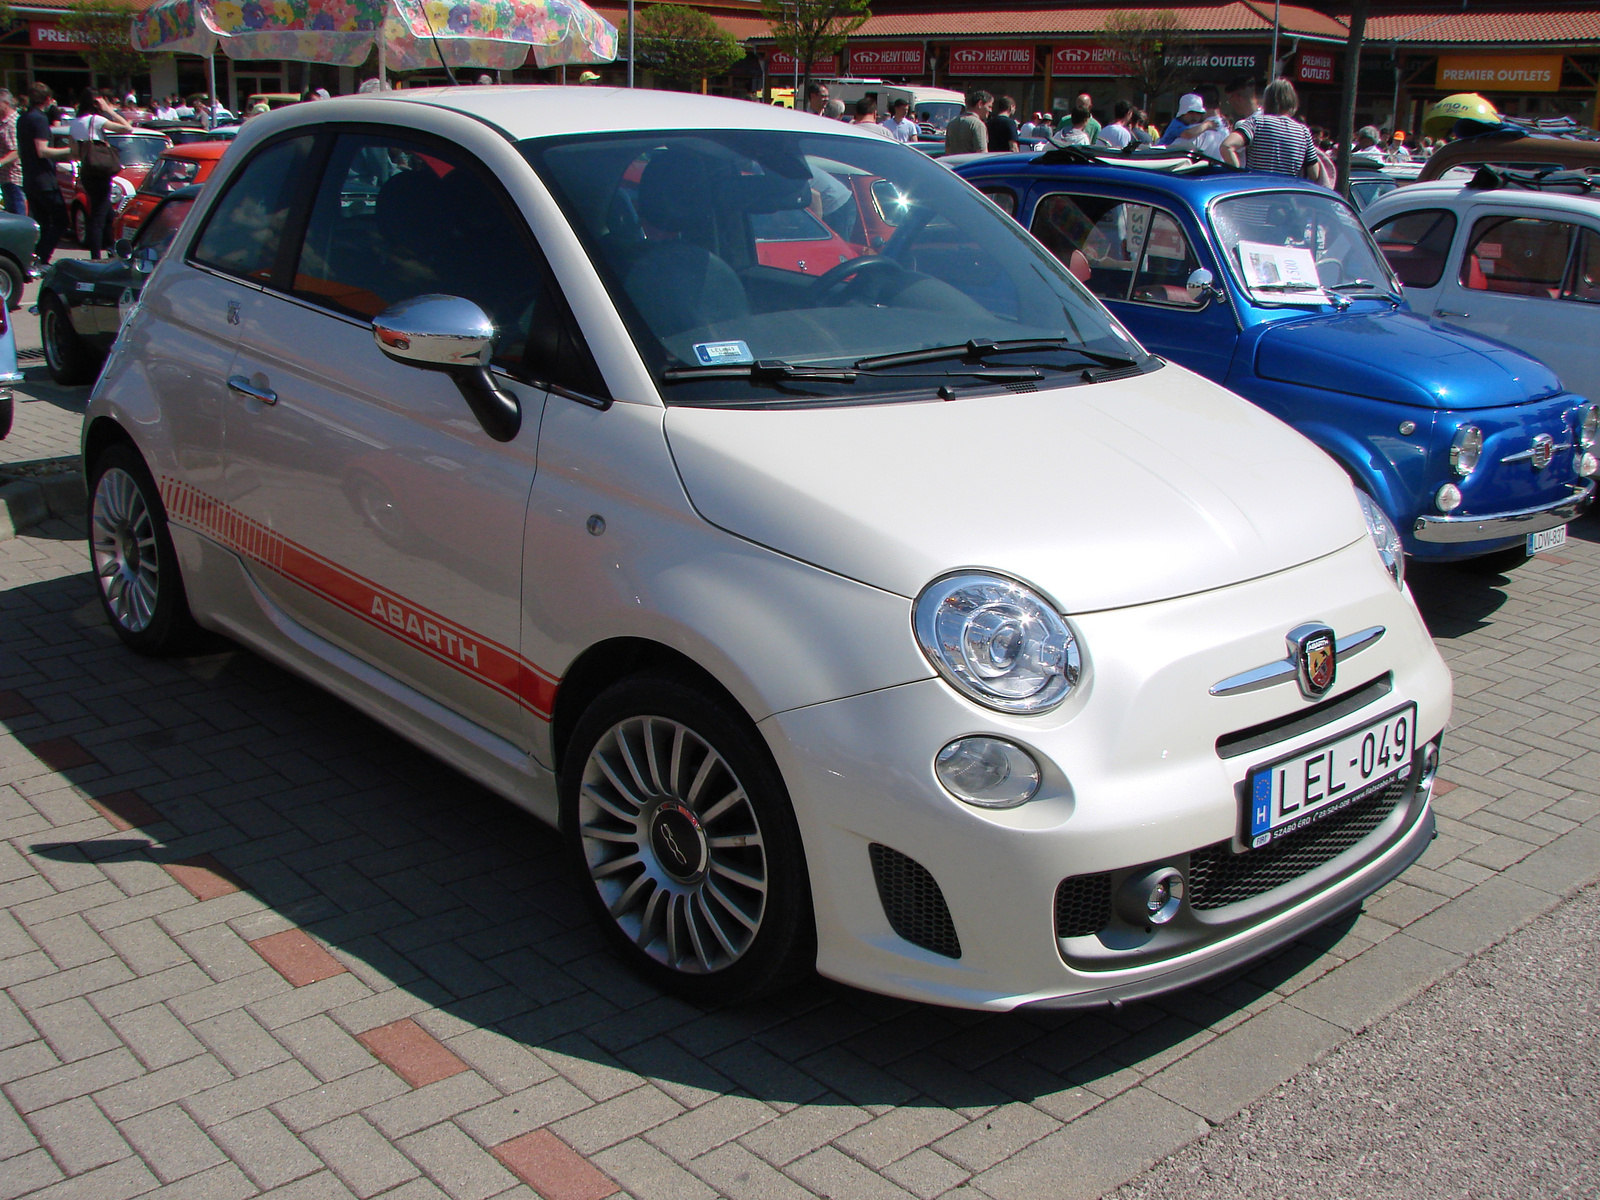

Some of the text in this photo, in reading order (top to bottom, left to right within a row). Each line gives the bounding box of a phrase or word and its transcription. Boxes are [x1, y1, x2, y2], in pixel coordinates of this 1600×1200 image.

[880, 50, 902, 63] HEAVY
[901, 50, 921, 63] TOOLS
[985, 49, 1008, 62] HEAVY
[1008, 49, 1030, 62] TOOLS
[1091, 48, 1117, 62] HEAVY
[1210, 55, 1256, 68] OUTLETS
[1301, 55, 1332, 68] PREMIER
[1301, 68, 1331, 81] OUTLETS
[1442, 69, 1552, 82] PREMIER OUTLETS
[1534, 527, 1565, 550] LDW-837
[371, 595, 481, 670] ABARTH
[1278, 716, 1408, 818] LEL-049
[1256, 804, 1267, 826] H
[1256, 835, 1269, 847] FIAT
